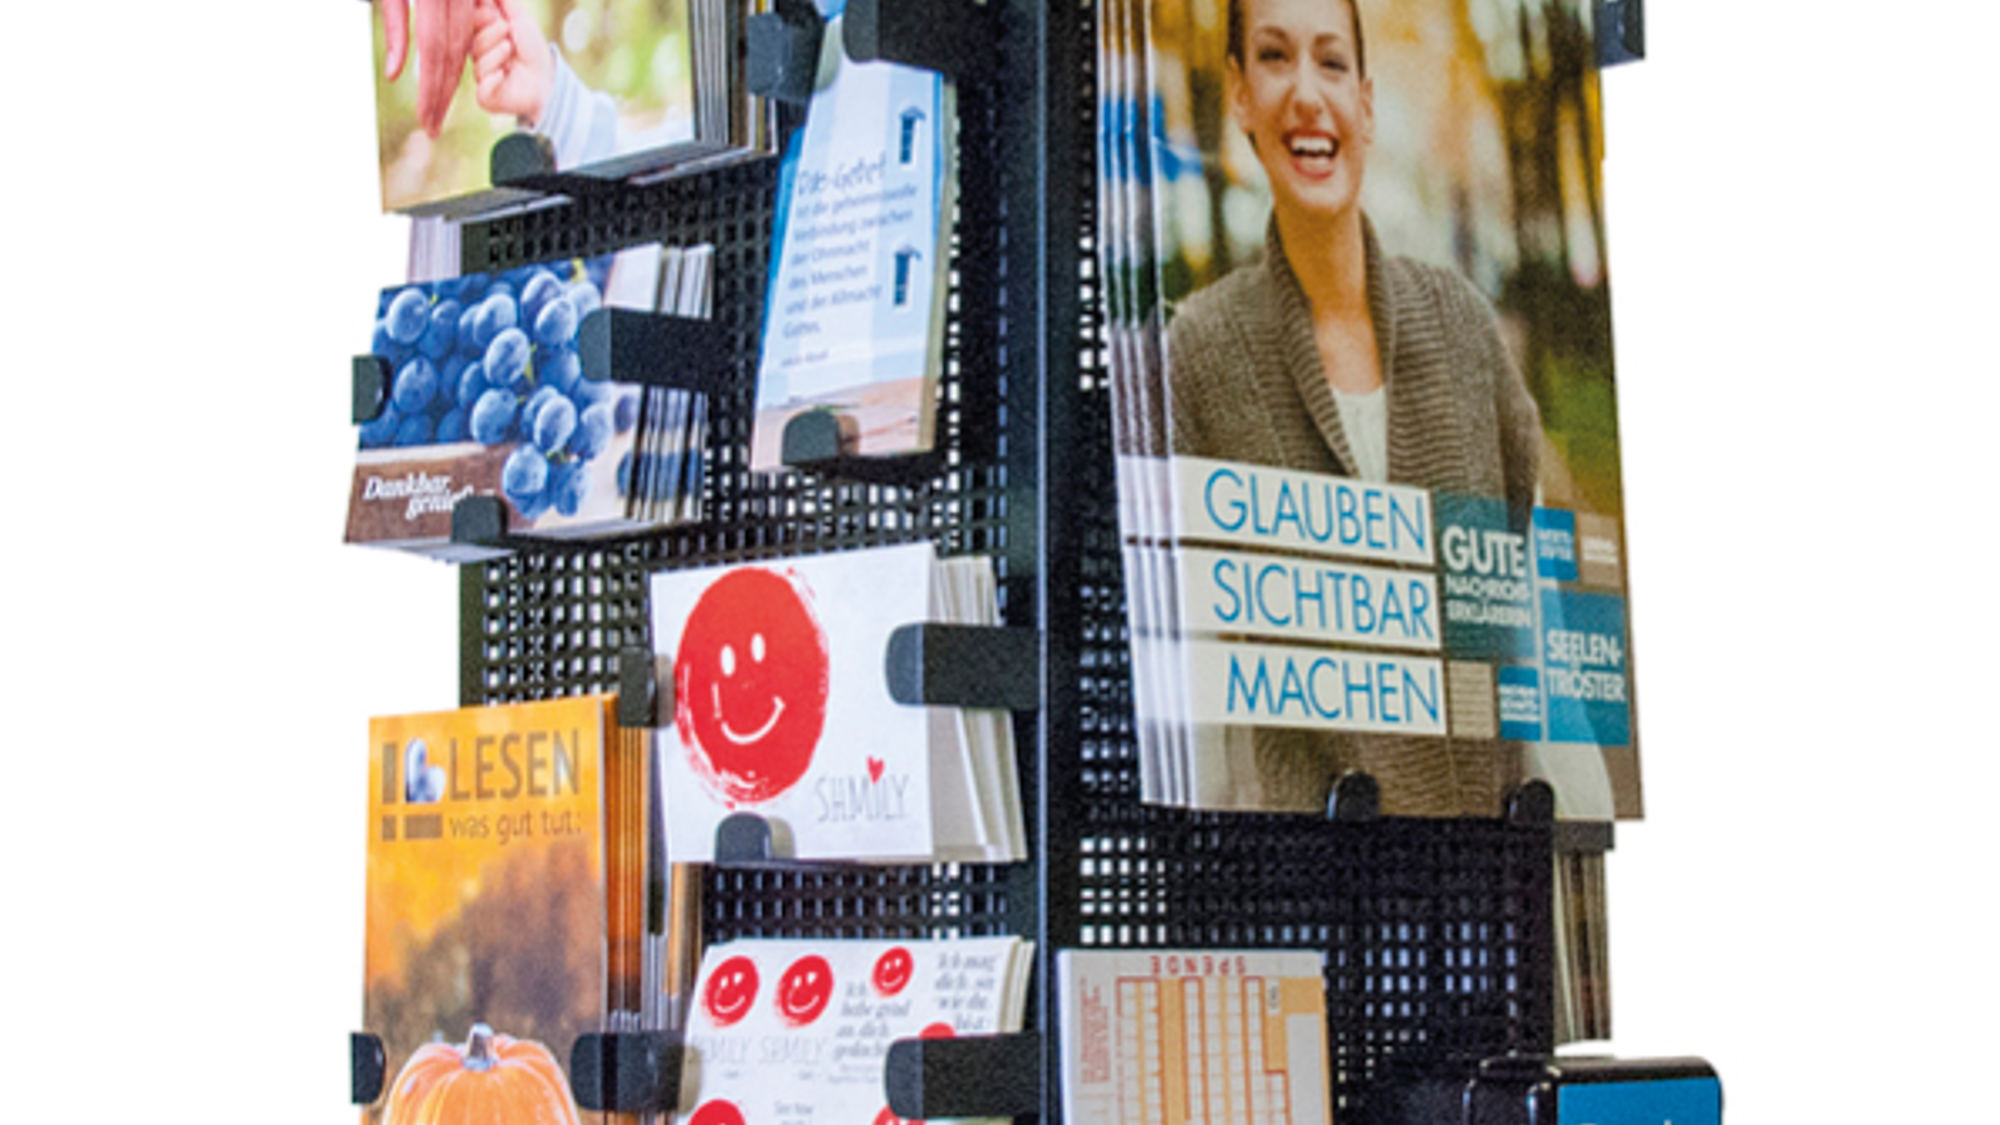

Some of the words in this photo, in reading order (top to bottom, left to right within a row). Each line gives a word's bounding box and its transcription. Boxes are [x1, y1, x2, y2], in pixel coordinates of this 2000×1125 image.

[1204, 468, 1426, 551] GLAUBEN
[1442, 525, 1525, 577] GUTE
[1213, 558, 1434, 640] SICHTBAR
[1547, 628, 1623, 667] SEELEN-
[1227, 652, 1439, 725] MACHEN
[450, 728, 580, 801] LESEN
[450, 814, 490, 839] was
[497, 811, 533, 845] gut
[1150, 955, 1246, 975] SPENDE
